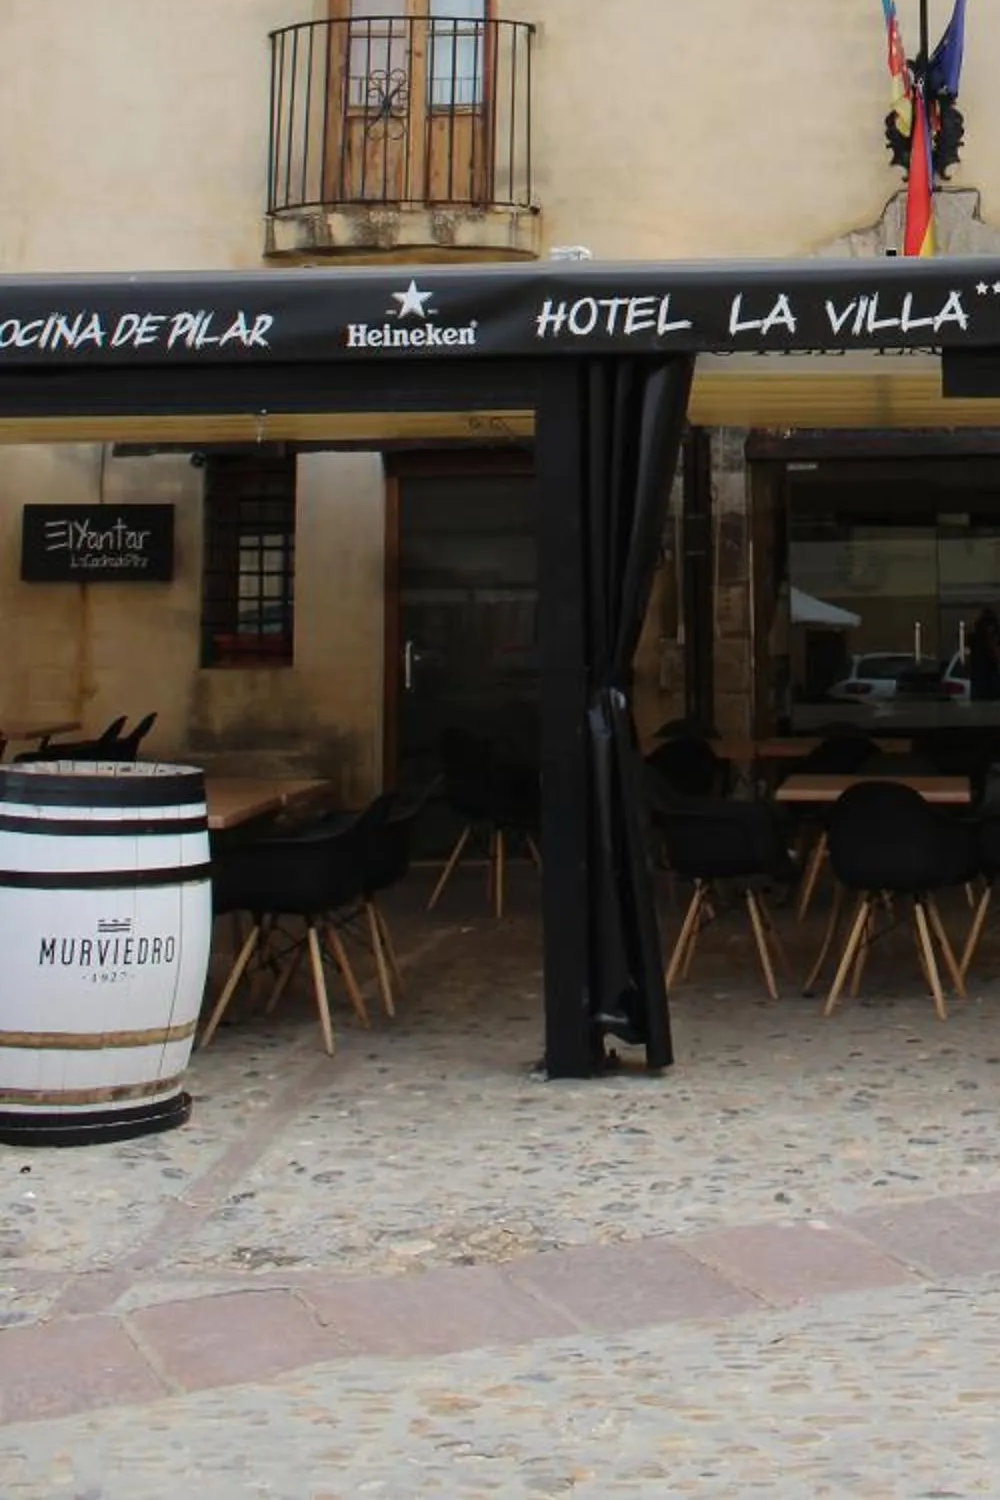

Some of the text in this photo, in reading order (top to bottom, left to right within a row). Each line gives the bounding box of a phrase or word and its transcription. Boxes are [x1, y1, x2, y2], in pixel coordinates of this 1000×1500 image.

[110, 312, 169, 349] DE
[166, 309, 274, 350] PILAR
[535, 291, 969, 337] HOTEL LA VILLA
[346, 322, 478, 348] Heineken
[39, 936, 176, 966] MURVIEDRO
